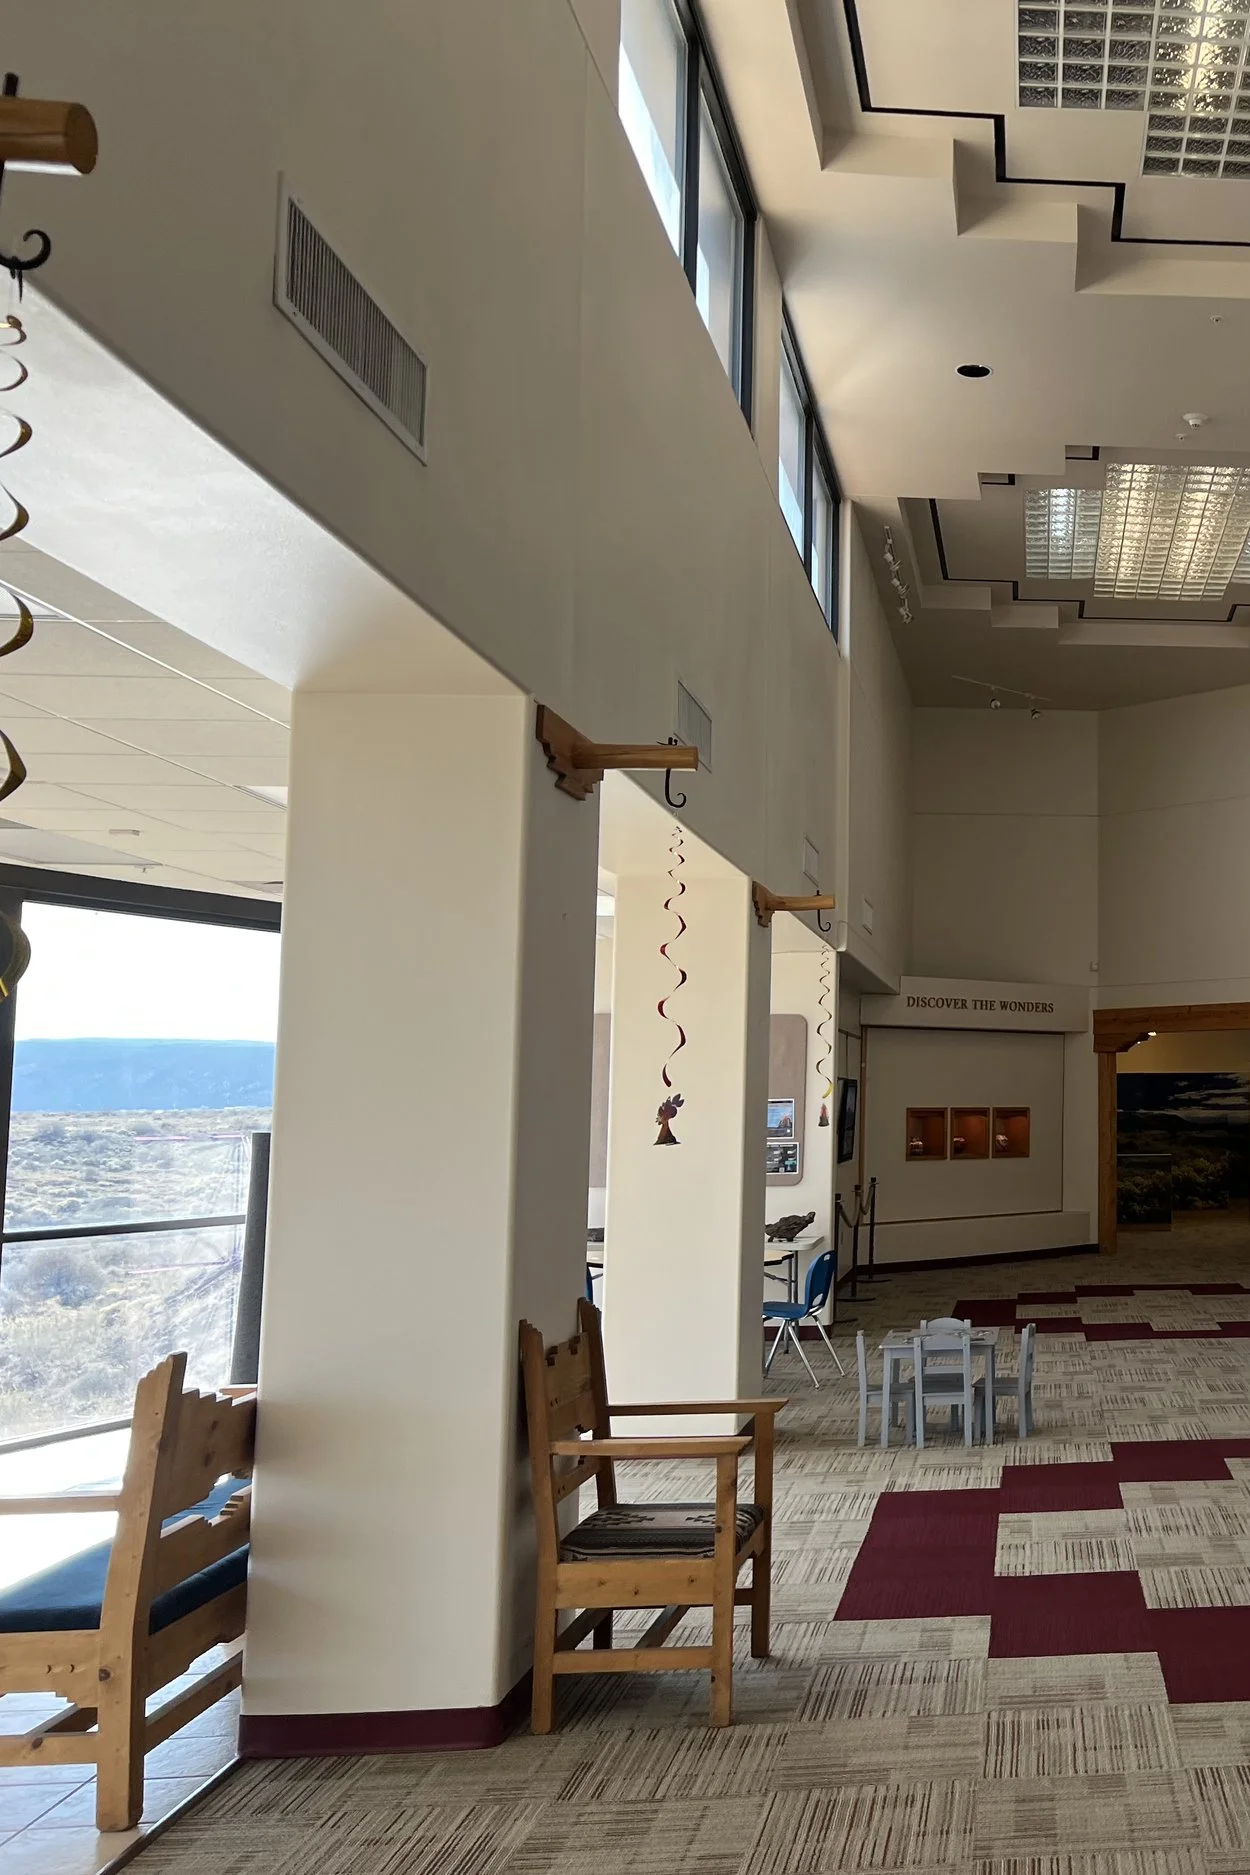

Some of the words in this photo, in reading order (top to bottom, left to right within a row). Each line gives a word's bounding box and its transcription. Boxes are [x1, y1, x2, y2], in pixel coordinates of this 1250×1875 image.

[906, 996, 968, 1010] DISCOVER
[972, 999, 996, 1011] THE
[1000, 1000, 1054, 1014] WONDERS
